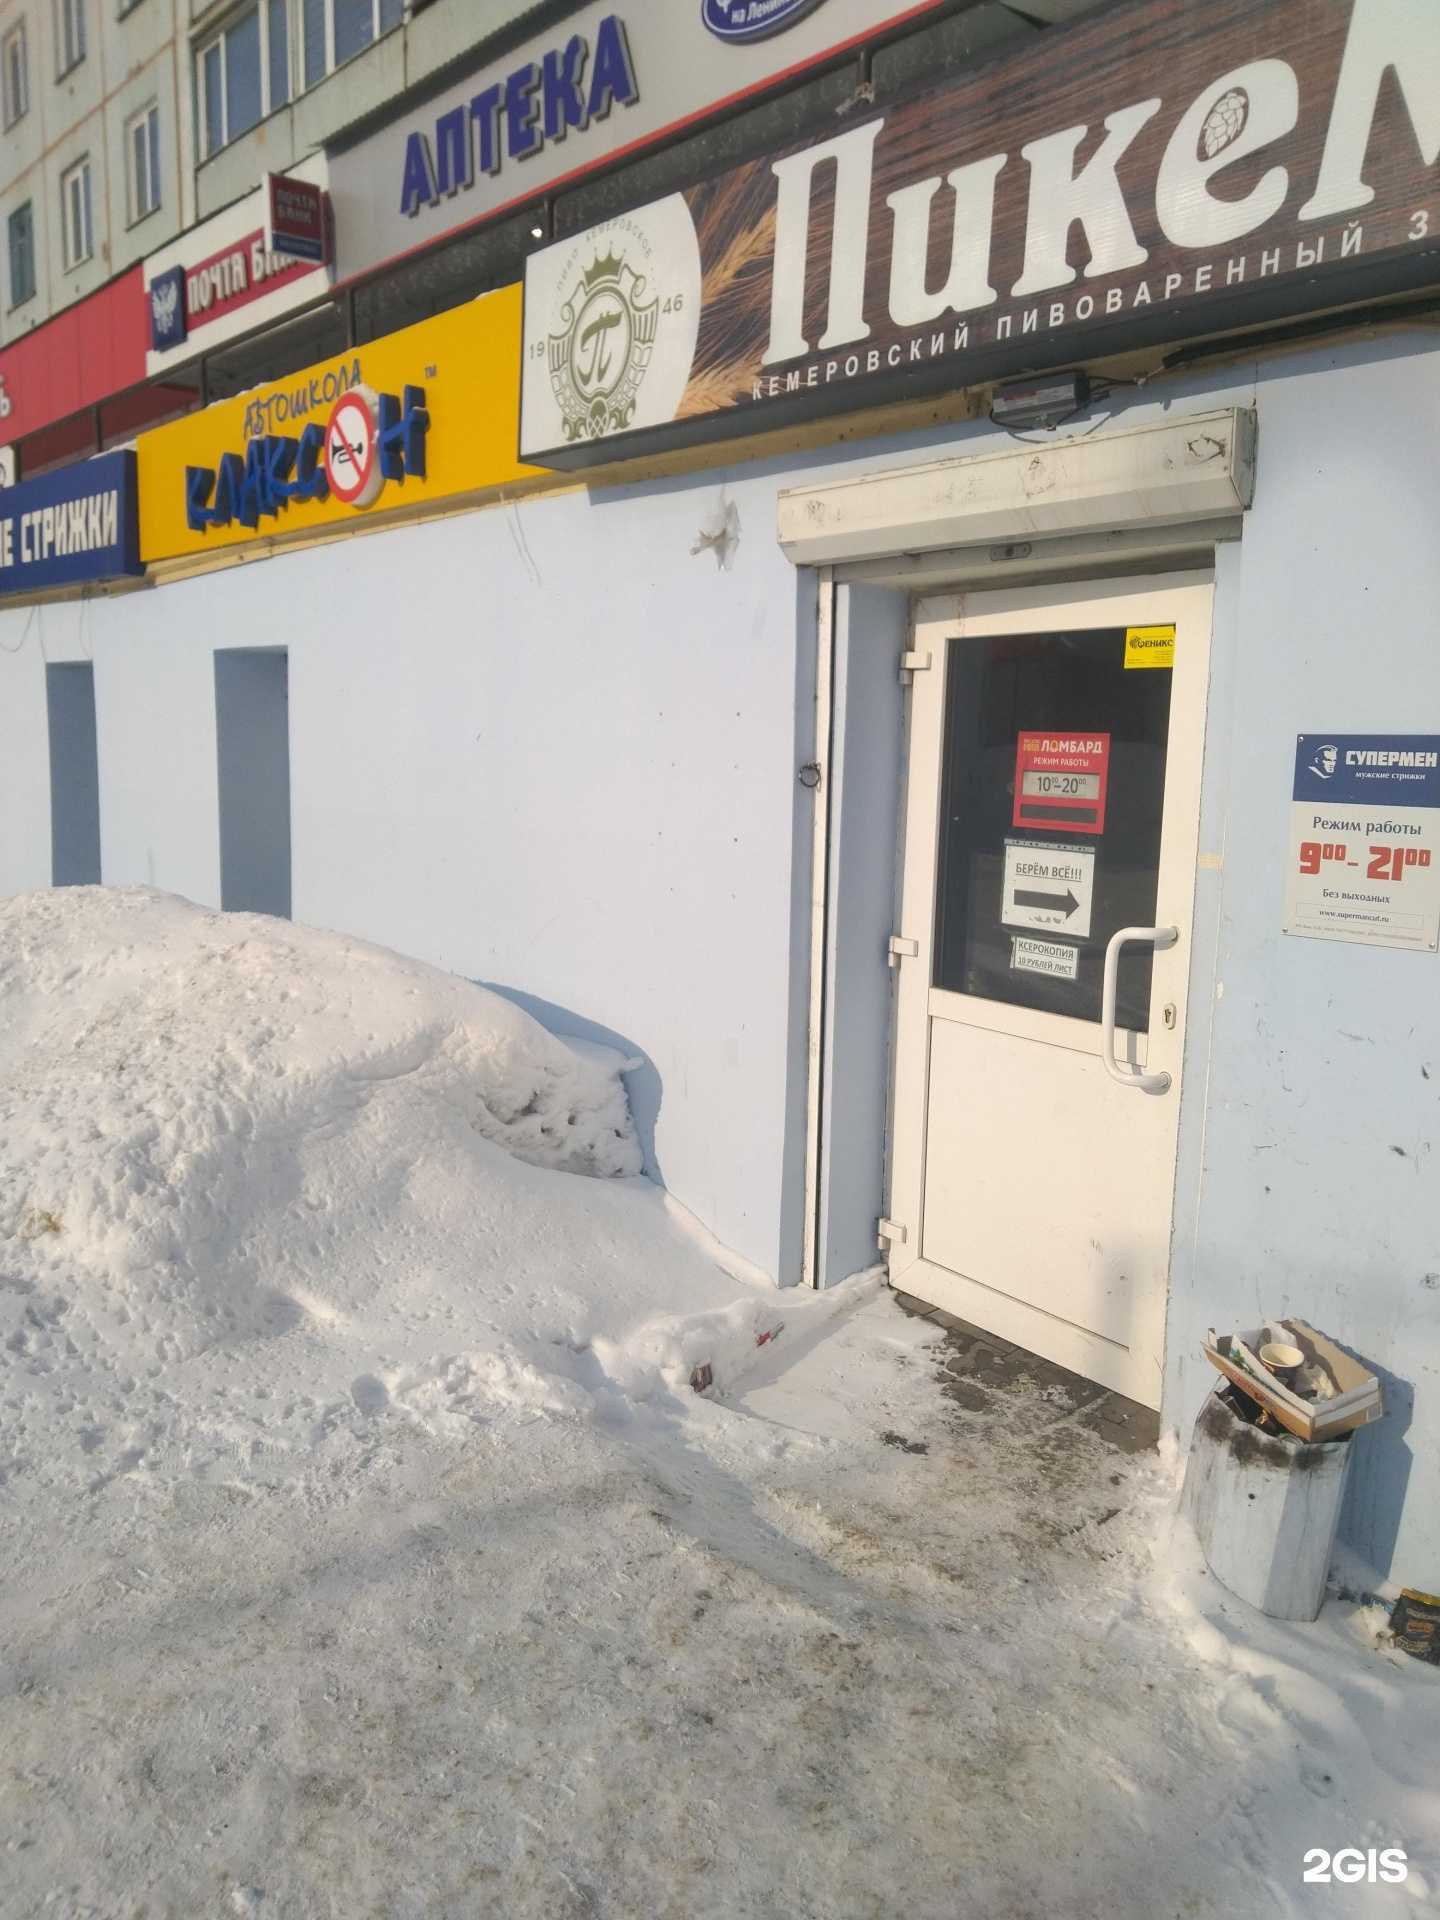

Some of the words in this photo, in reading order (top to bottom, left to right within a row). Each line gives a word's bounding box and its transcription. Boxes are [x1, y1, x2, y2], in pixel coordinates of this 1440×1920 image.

[400, 14, 638, 217] АПТЕКА
[186, 251, 248, 315] ПОЧТА
[752, 321, 968, 400] КЕМЕРОВСКИЙ
[996, 221, 1363, 340] ПИВОВАРЕННЫЙ
[529, 341, 545, 360] 19
[661, 294, 683, 314] 46
[243, 358, 363, 440] АВТОШКОЛА
[21, 490, 118, 564] СТРИЖКИ
[1041, 739, 1103, 754] ЛОМБАРД
[1033, 756, 1059, 767] РЕЖИМ
[1060, 758, 1089, 768] РАБОТЫ
[1345, 750, 1437, 768] СУПЕРМЕН
[1355, 771, 1390, 781] мужские
[1391, 772, 1426, 781] стрижки
[1312, 816, 1361, 832] Режим
[1366, 820, 1422, 836] работы
[1016, 861, 1049, 877] БЕРЁМ
[1051, 865, 1082, 880] ВСЁ!!!
[1322, 888, 1340, 899] Без
[1341, 891, 1390, 904] выходных
[1018, 940, 1073, 960] КСЕРОКОПИЯ
